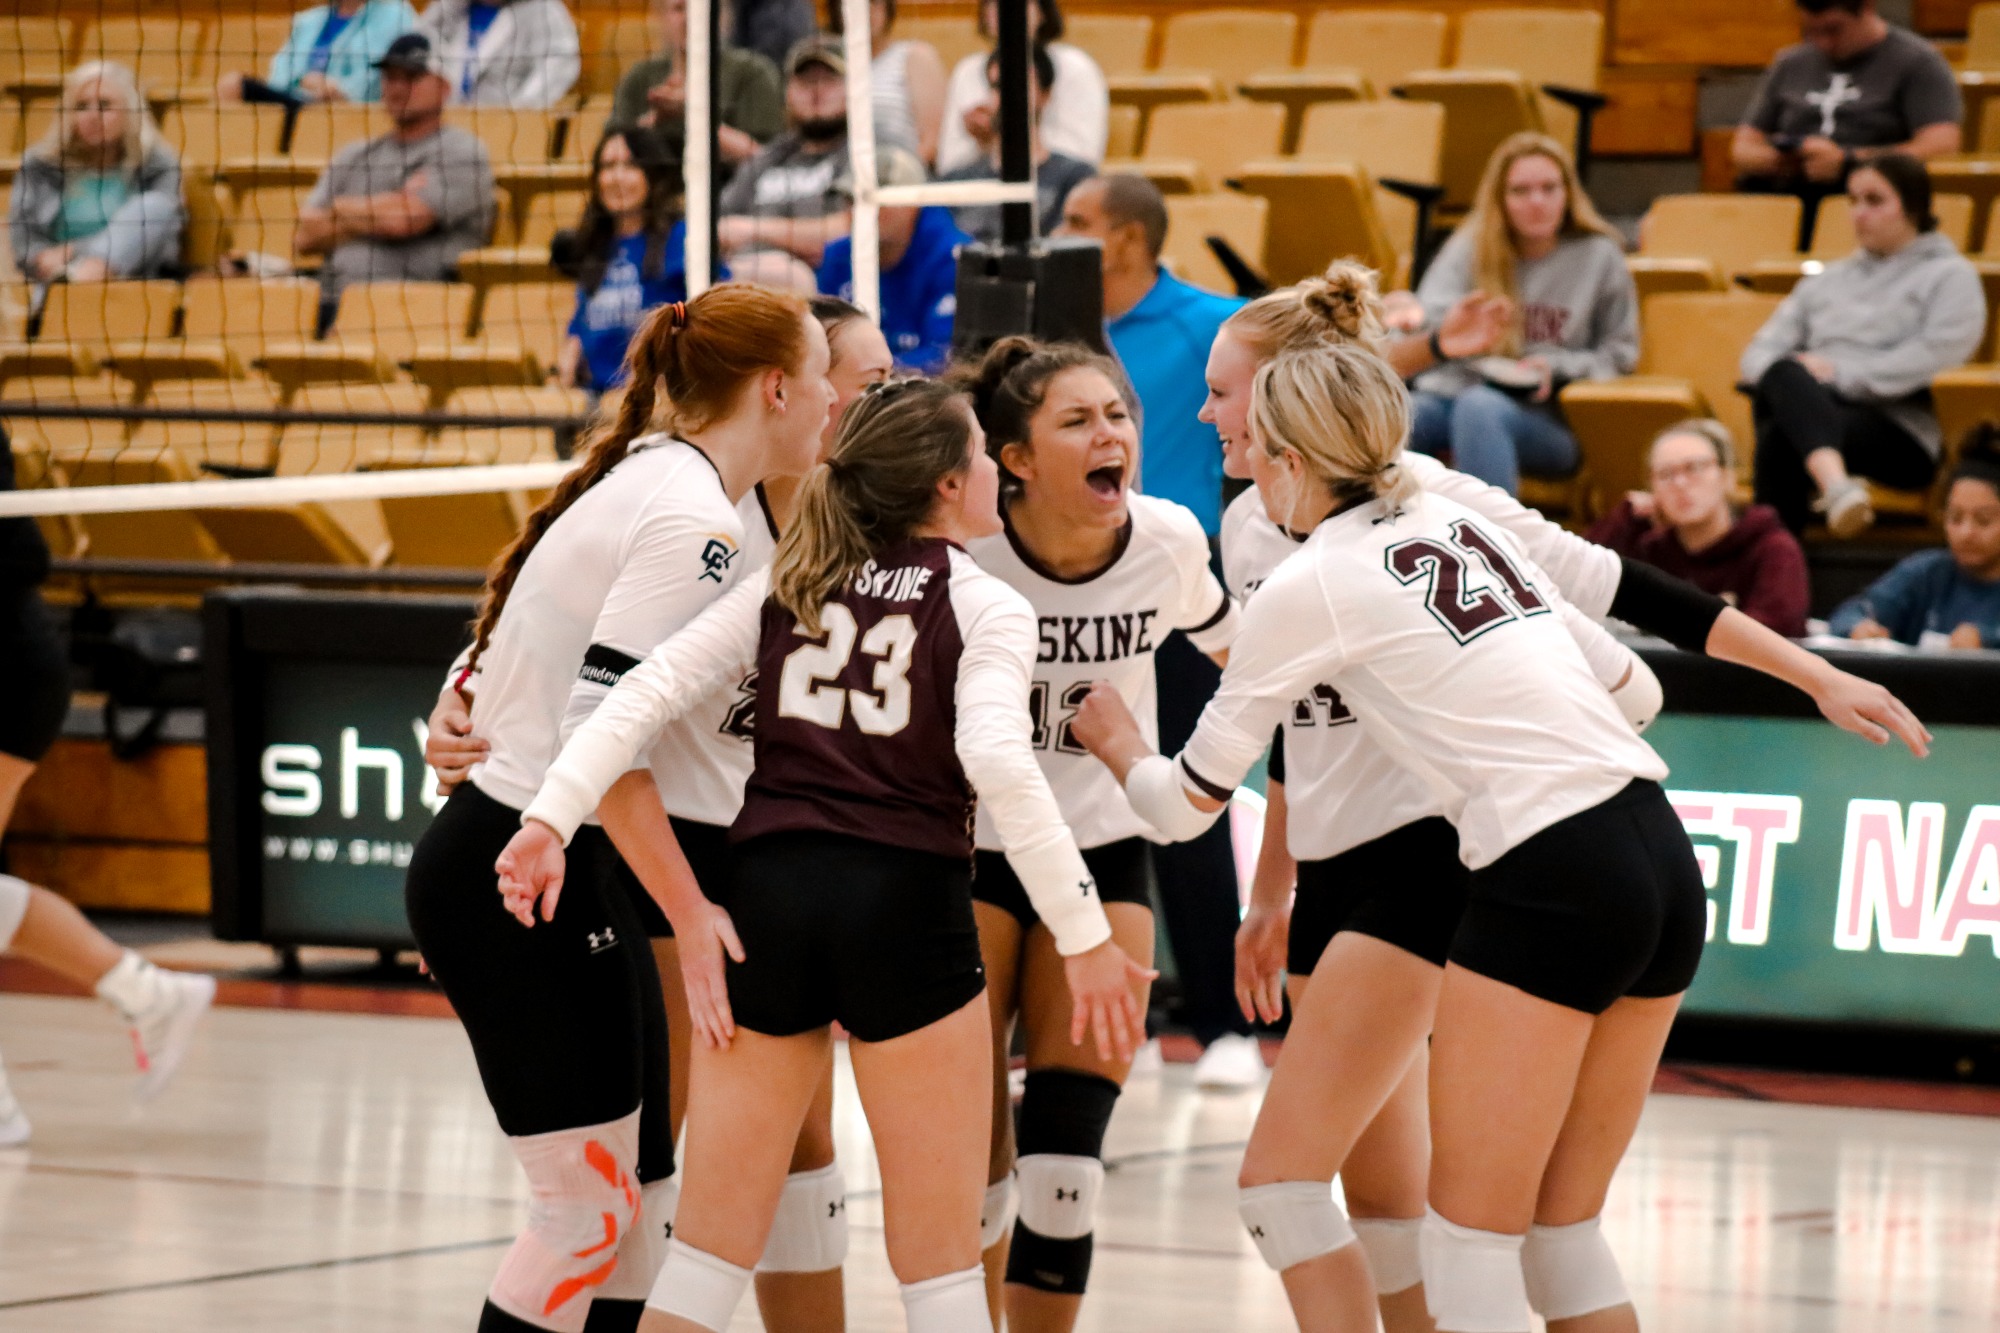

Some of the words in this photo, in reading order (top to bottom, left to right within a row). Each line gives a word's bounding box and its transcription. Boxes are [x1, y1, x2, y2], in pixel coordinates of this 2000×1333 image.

[848, 558, 934, 602] SKINE
[1384, 518, 1552, 647] 21
[778, 601, 919, 737] 23
[1036, 608, 1158, 663] SKINE
